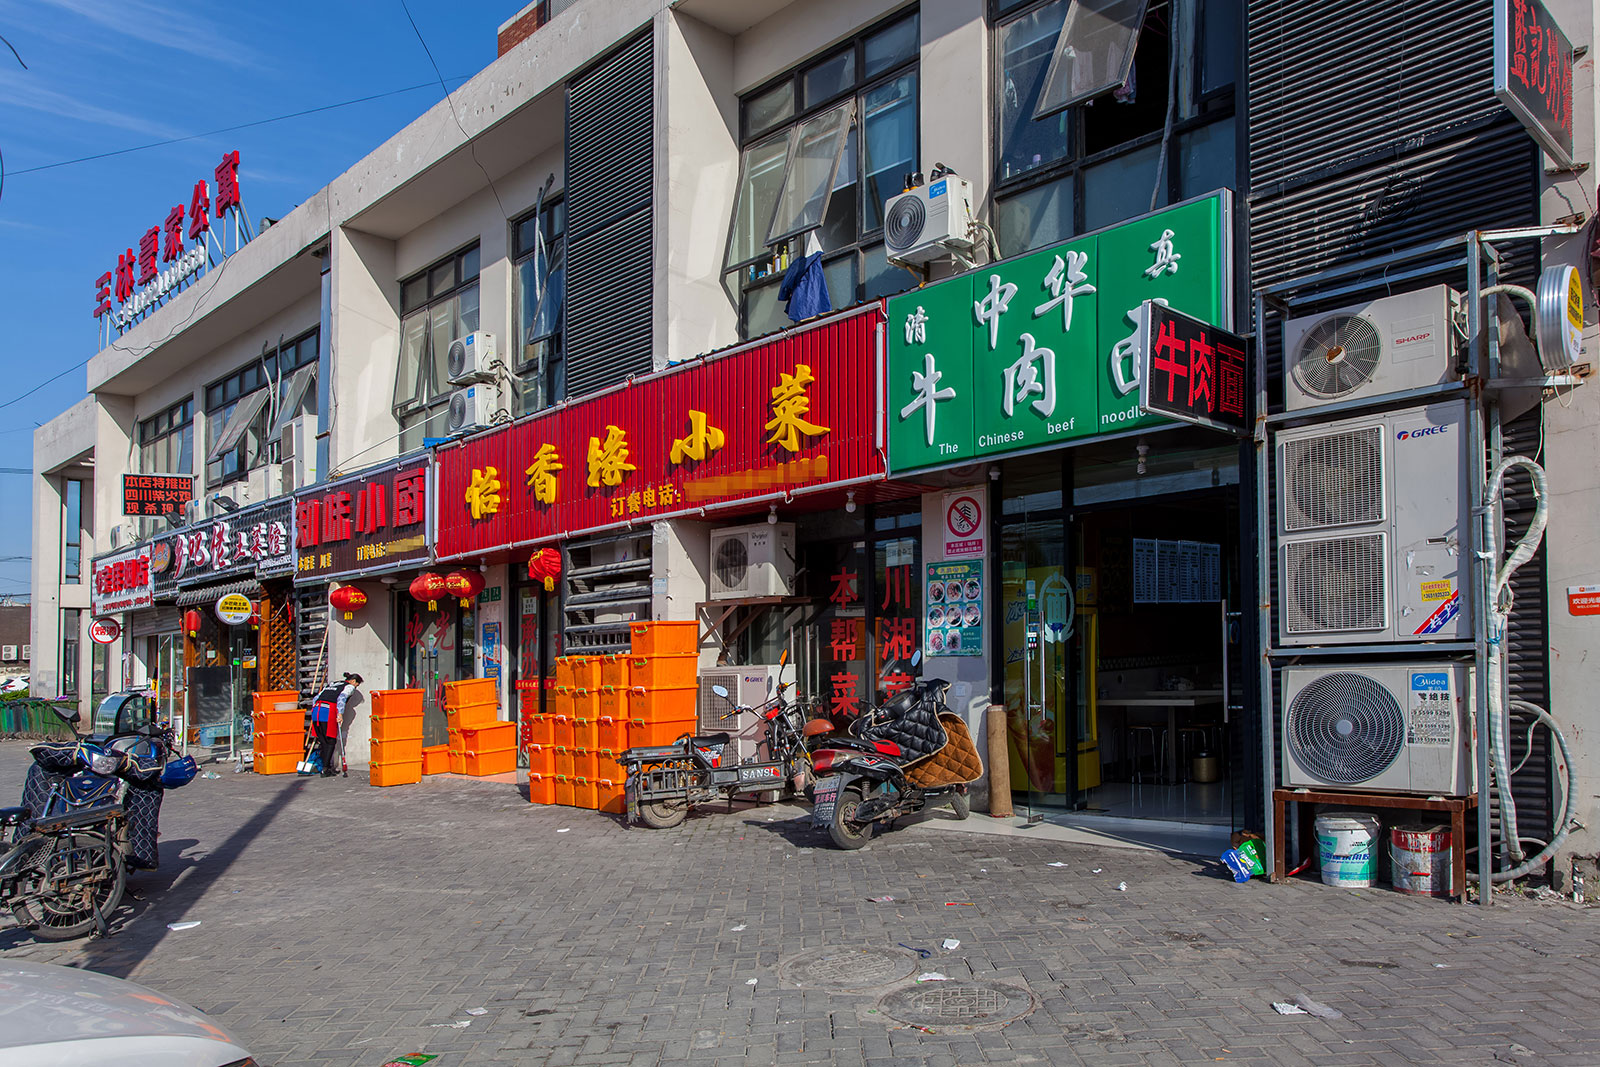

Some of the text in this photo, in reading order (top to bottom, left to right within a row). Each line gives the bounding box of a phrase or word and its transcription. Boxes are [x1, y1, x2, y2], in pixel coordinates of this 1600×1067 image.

[1395, 332, 1431, 345] SHARP
[1154, 319, 1246, 418] 牛肉面
[465, 363, 832, 520] 怡香缘小菜
[939, 442, 959, 455] The
[978, 429, 1025, 448] Chinese
[1047, 418, 1075, 435] beef
[1411, 424, 1448, 440] GREE
[125, 476, 192, 490] 本店特推出
[125, 489, 192, 502] 四川柴火鸡
[296, 467, 425, 550] 知味小厨
[829, 567, 859, 716] 本帮菜
[742, 768, 774, 779] SANSI
